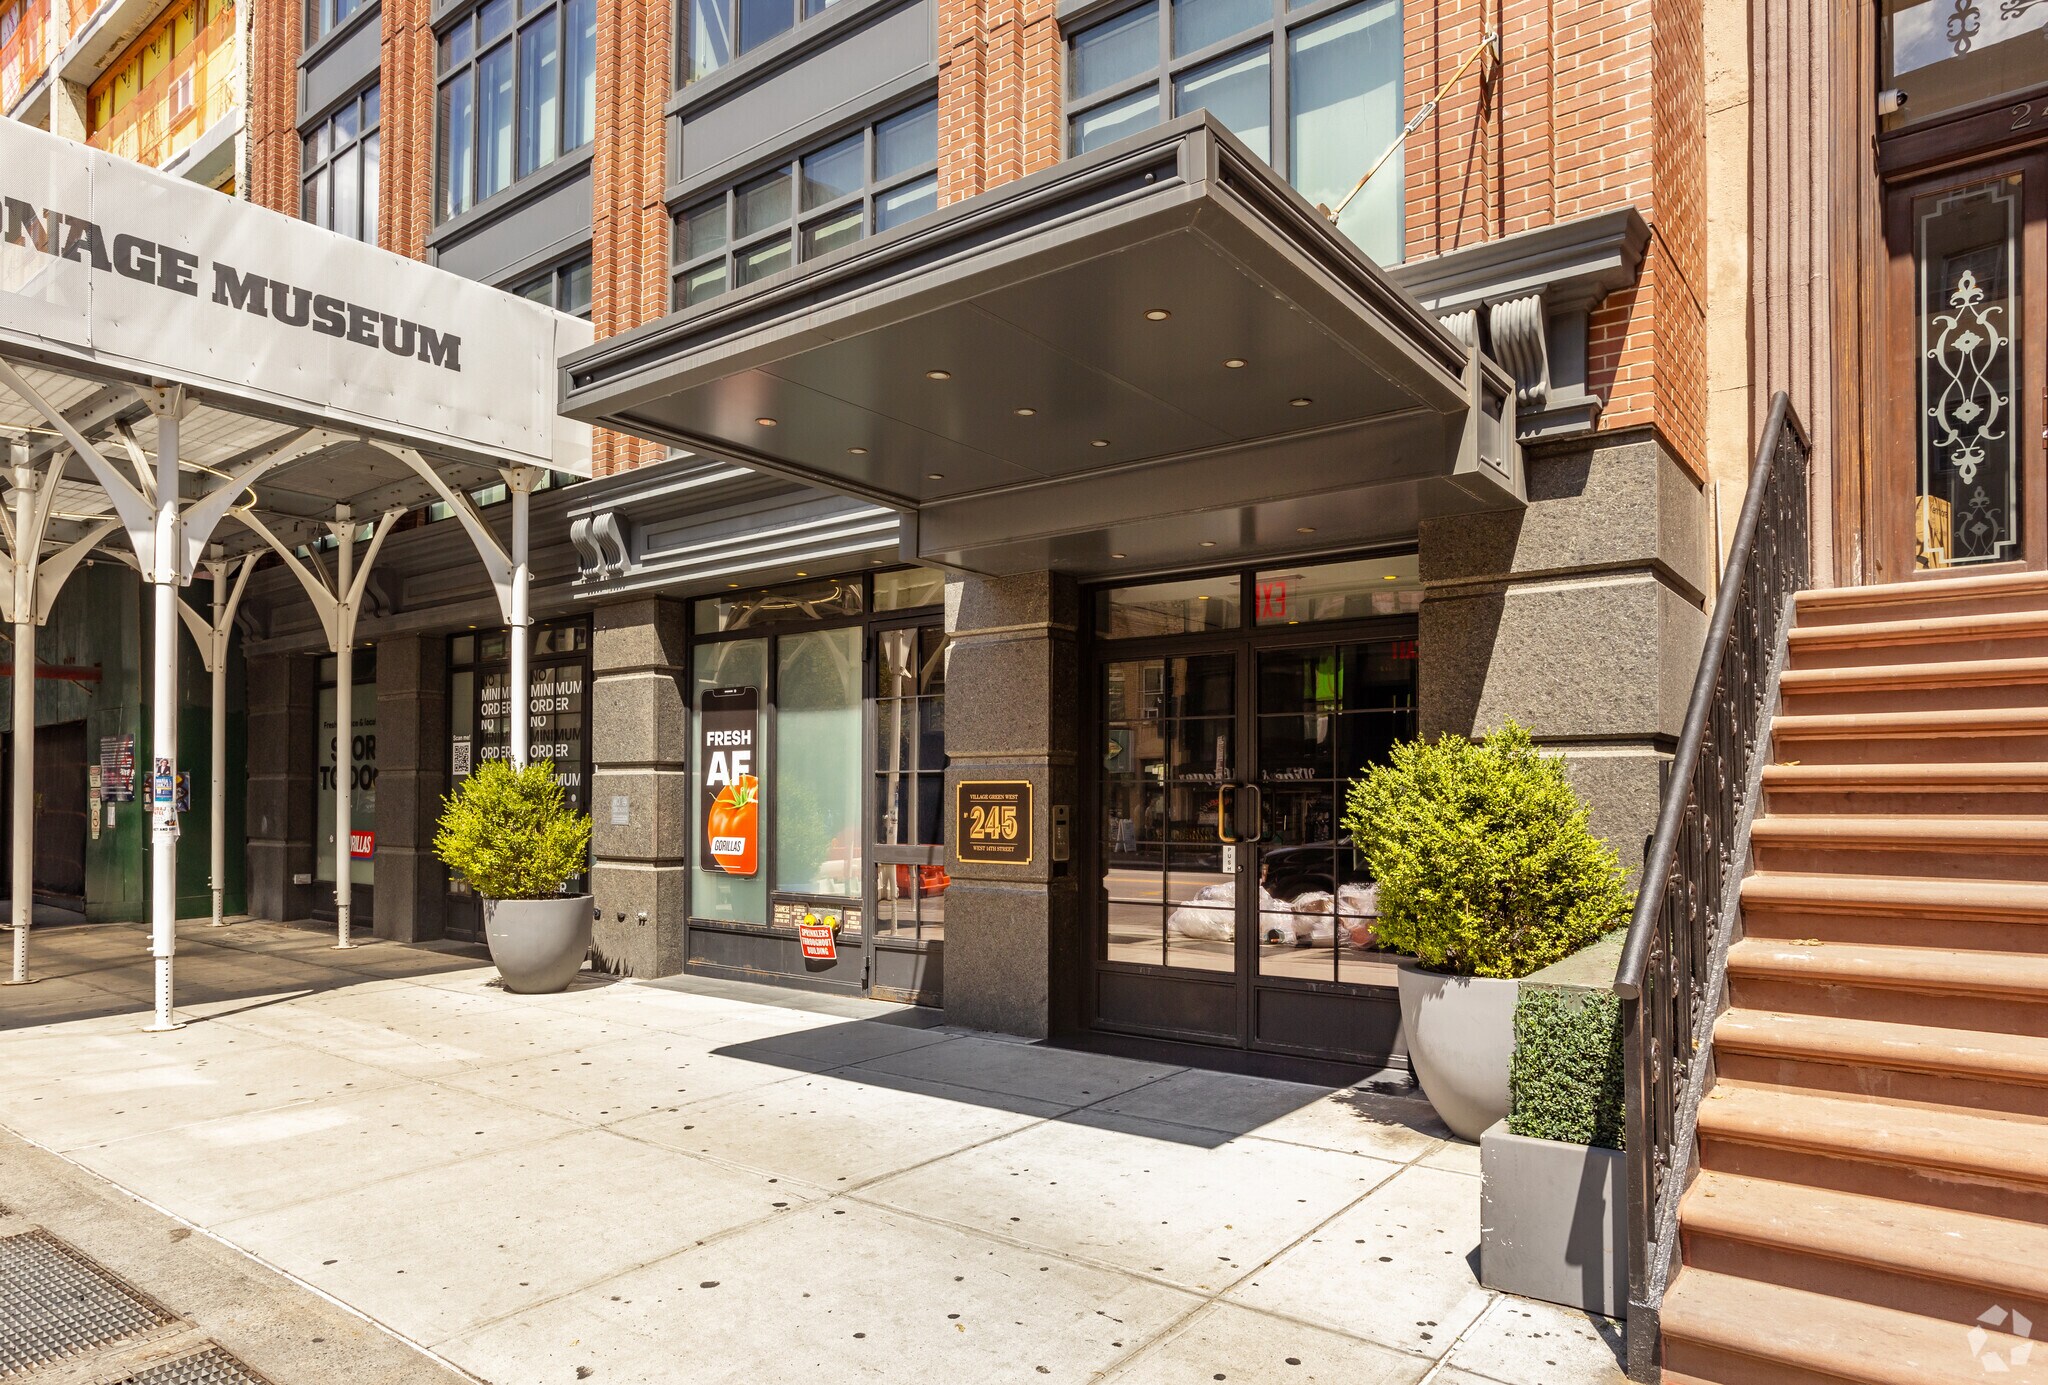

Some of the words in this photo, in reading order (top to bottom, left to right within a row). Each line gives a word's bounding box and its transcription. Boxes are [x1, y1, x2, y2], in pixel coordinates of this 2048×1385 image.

[2010, 103, 2048, 130] 2
[0, 196, 198, 297] NAGE
[212, 261, 461, 372] MUSEUM
[481, 686, 512, 701] MINIM
[530, 680, 582, 697] MINIMUM
[481, 701, 512, 716] ORDER
[530, 697, 569, 713] ORDER
[481, 719, 494, 730] NO
[530, 715, 547, 727] NO
[531, 727, 581, 742] MINIMUM
[706, 730, 752, 747] FRESH
[530, 743, 568, 758] ORDER
[706, 750, 752, 787] AF
[970, 806, 1017, 839] 245
[351, 836, 372, 853] RILLAS
[714, 840, 742, 852] GORILLAS
[801, 928, 829, 938] SPRINKLERS
[802, 937, 832, 947] THROUGHOUT
[807, 946, 829, 956] BUILDING
